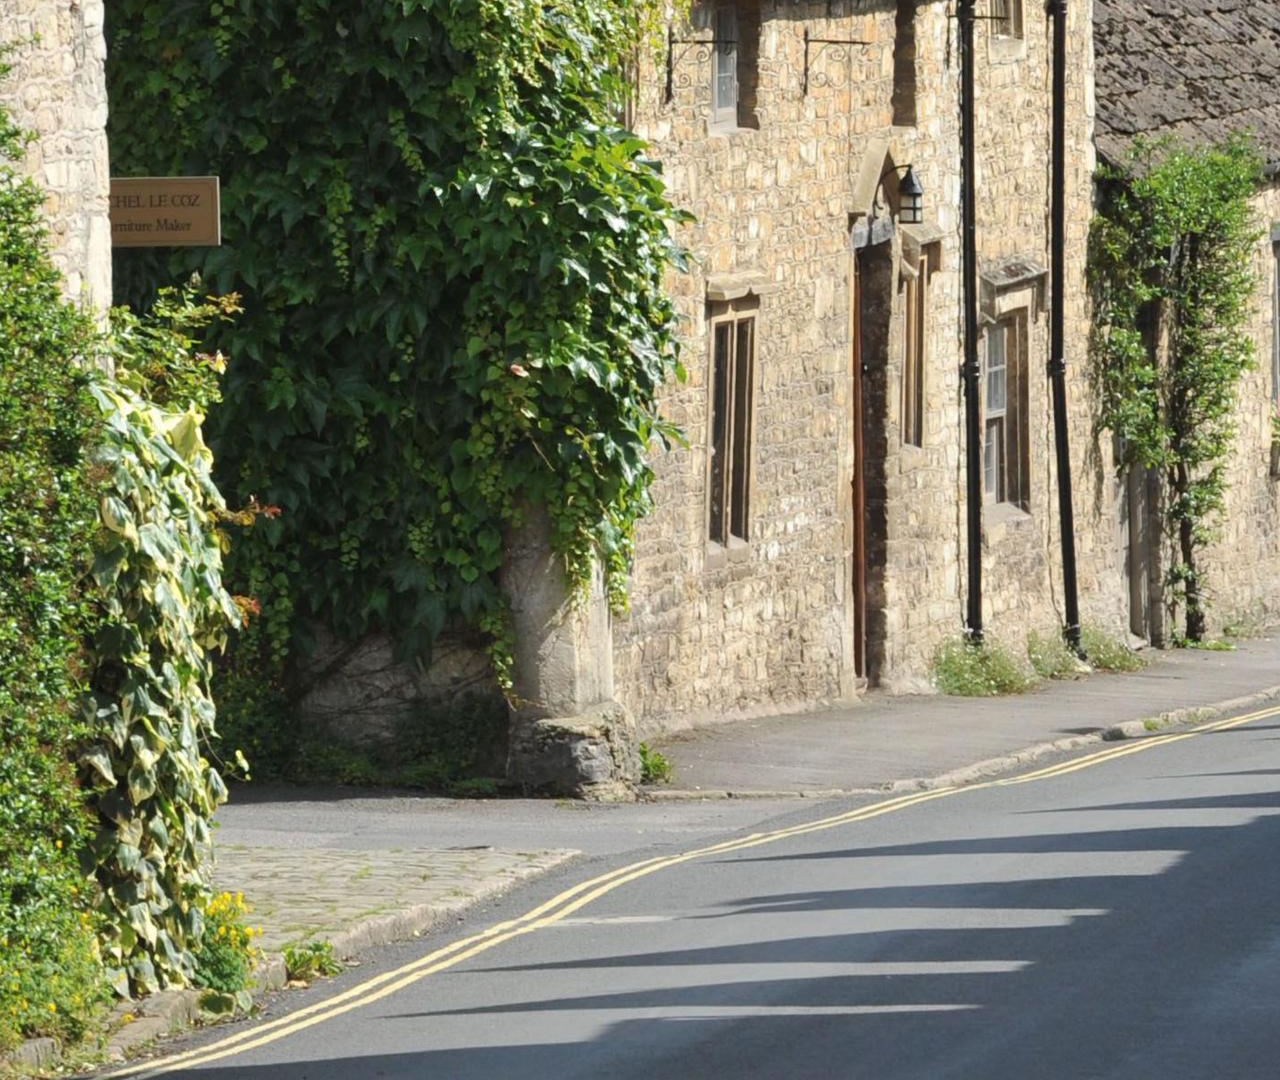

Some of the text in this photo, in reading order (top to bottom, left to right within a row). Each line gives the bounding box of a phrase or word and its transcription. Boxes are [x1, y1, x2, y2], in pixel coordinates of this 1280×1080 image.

[149, 194, 167, 208] LE
[171, 193, 200, 207] COZ
[156, 218, 192, 232] Maker
